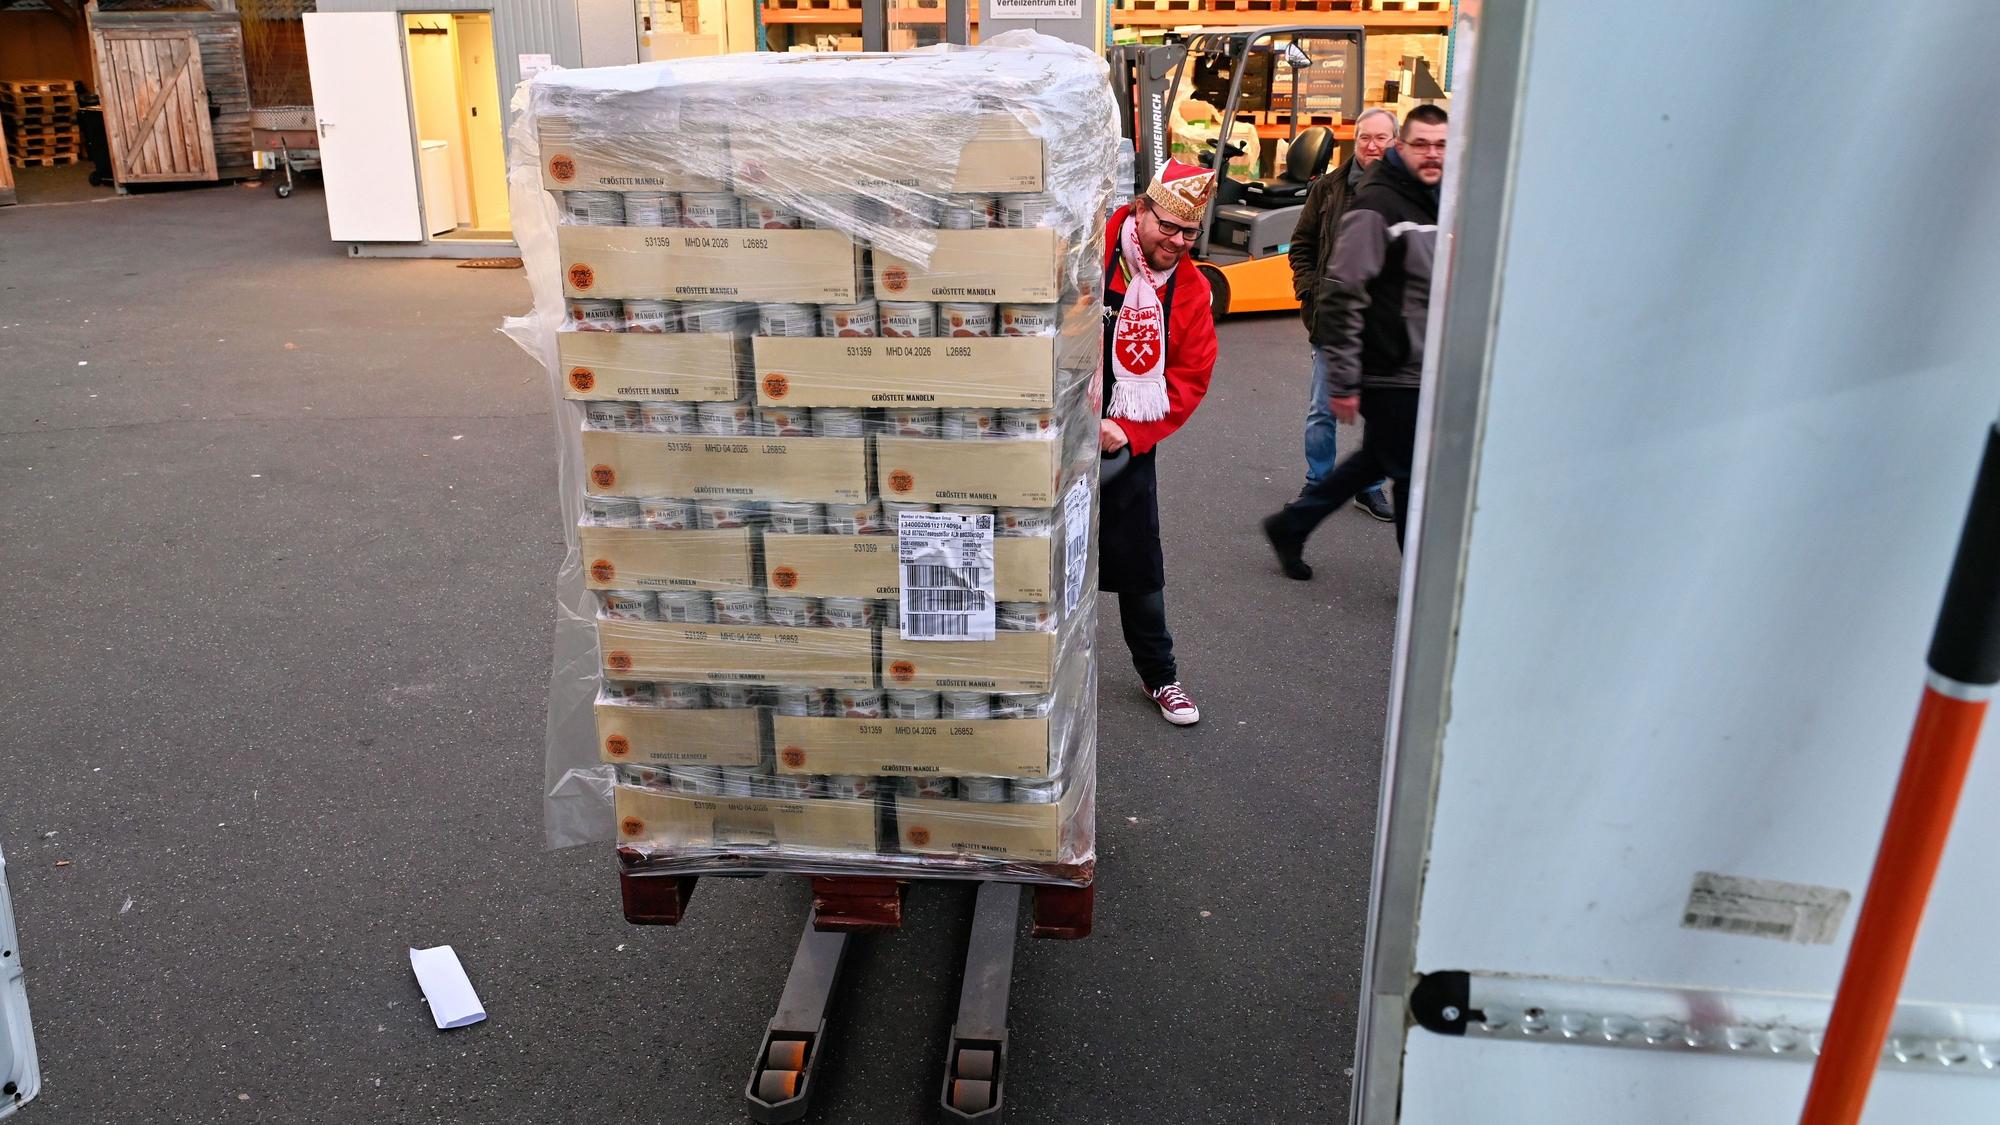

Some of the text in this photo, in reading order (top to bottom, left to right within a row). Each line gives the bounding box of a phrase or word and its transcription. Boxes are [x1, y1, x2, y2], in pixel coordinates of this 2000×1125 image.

[1152, 93, 1164, 174] NGHEINRICH
[645, 238, 768, 249] 531359 MHD 04.2026 L26852
[675, 286, 738, 295] GERÖSTETE MANDELN
[932, 286, 996, 296] GERÖSTETE MANDELN
[585, 309, 614, 318] MANDELN
[889, 317, 917, 325] MANDELN
[1014, 317, 1043, 325] MANDELN
[847, 347, 971, 357] 531359 MHD 04.2026 L26852
[617, 386, 649, 395] GERÖSTETE
[871, 393, 905, 401] GERÖSTETE
[705, 444, 721, 452] MHD
[936, 491, 997, 500] GERÖSTETE MANDELN
[854, 544, 877, 552] 531359
[615, 602, 642, 610] MANDELN
[936, 679, 996, 688] GERÖSTETE MANDELN
[860, 726, 974, 736] 531359 MHD 04.2026 L26852
[881, 764, 912, 772] GERÖSTETE
